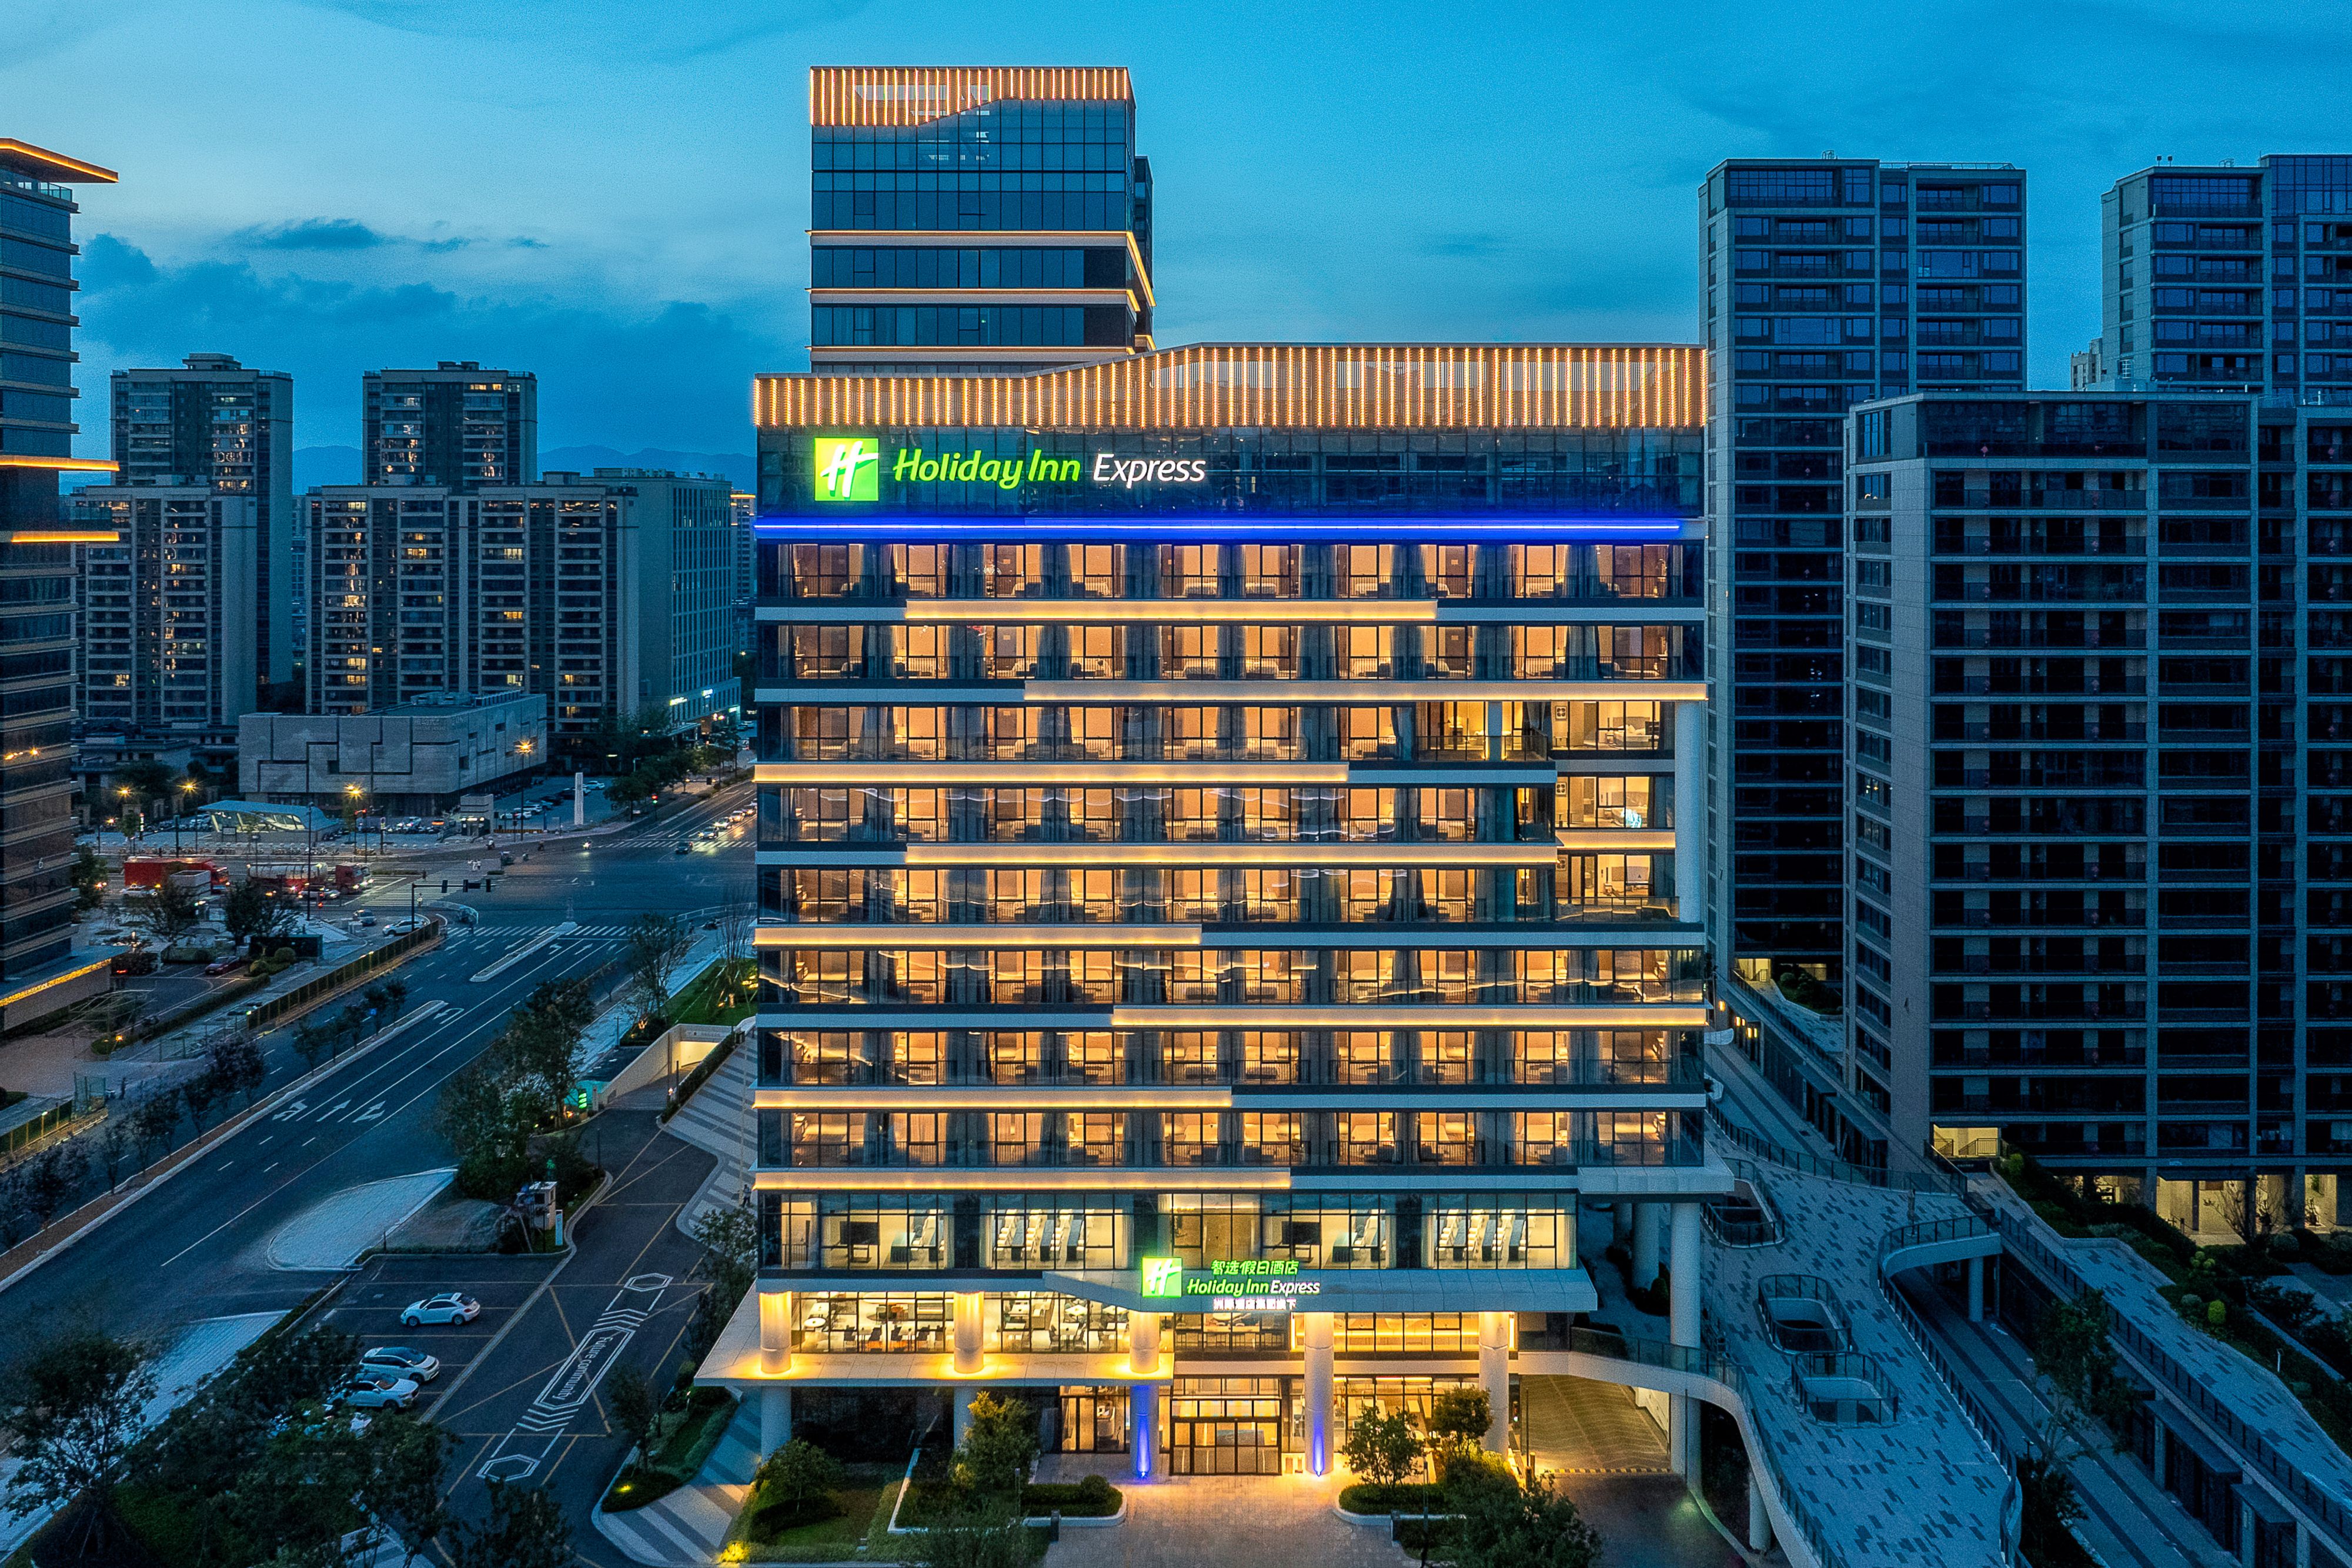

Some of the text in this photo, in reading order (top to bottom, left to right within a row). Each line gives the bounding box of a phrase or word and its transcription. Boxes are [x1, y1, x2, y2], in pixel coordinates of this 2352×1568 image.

[892, 448, 1207, 490] Holiday Inn Express
[38, 857, 44, 869] 6
[1211, 1259, 1299, 1276] 智选假日酒店
[1187, 1278, 1321, 1298] Holiday Inn Express
[552, 1336, 614, 1400] Future community
